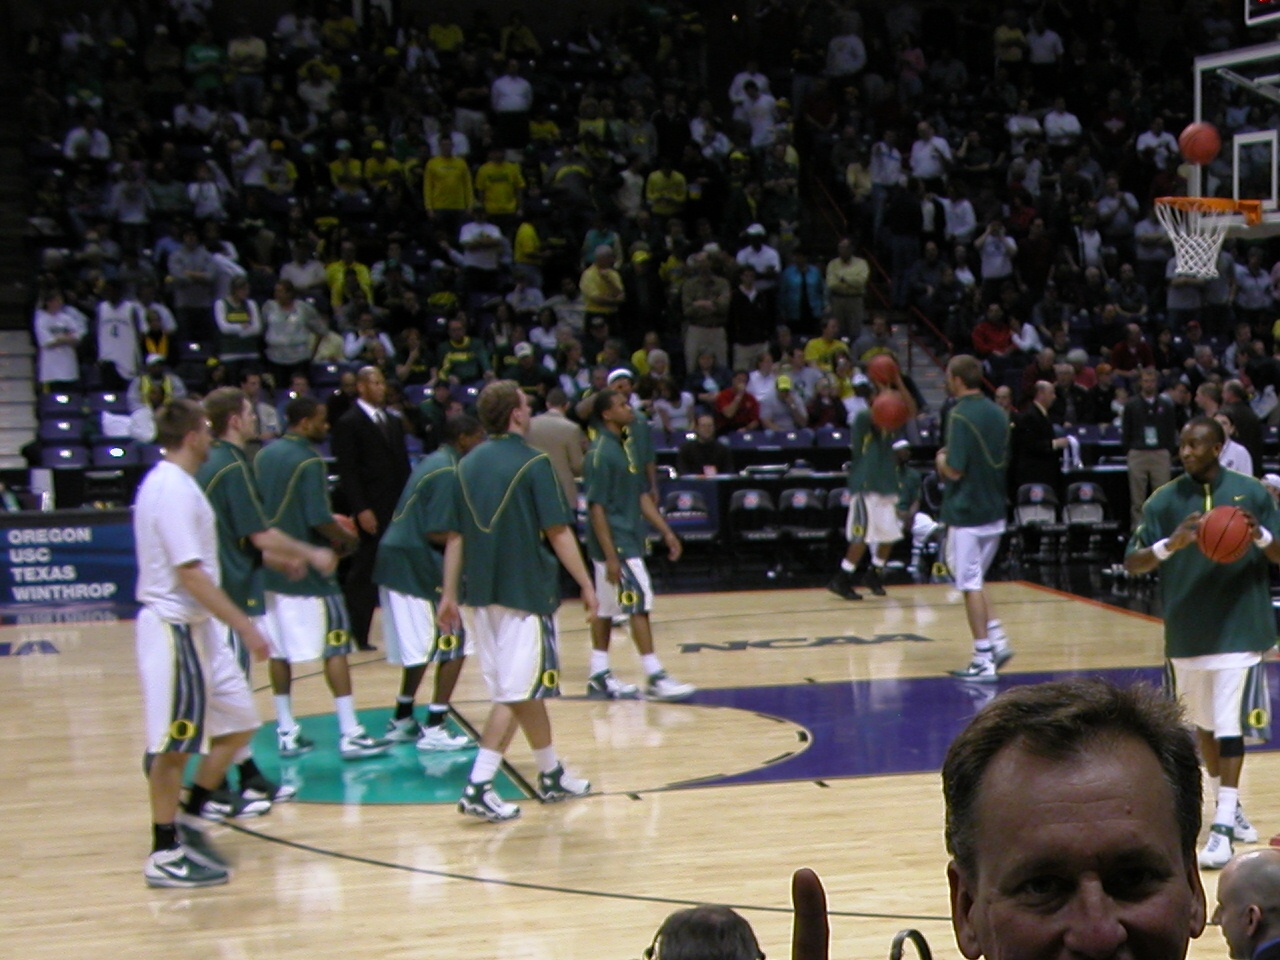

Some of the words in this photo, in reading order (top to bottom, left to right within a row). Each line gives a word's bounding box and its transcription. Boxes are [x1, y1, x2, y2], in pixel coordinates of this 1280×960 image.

[8, 527, 92, 544] OREGON
[9, 547, 51, 563] USC
[10, 565, 77, 582] TEXAS
[12, 583, 118, 601] WINTHROP
